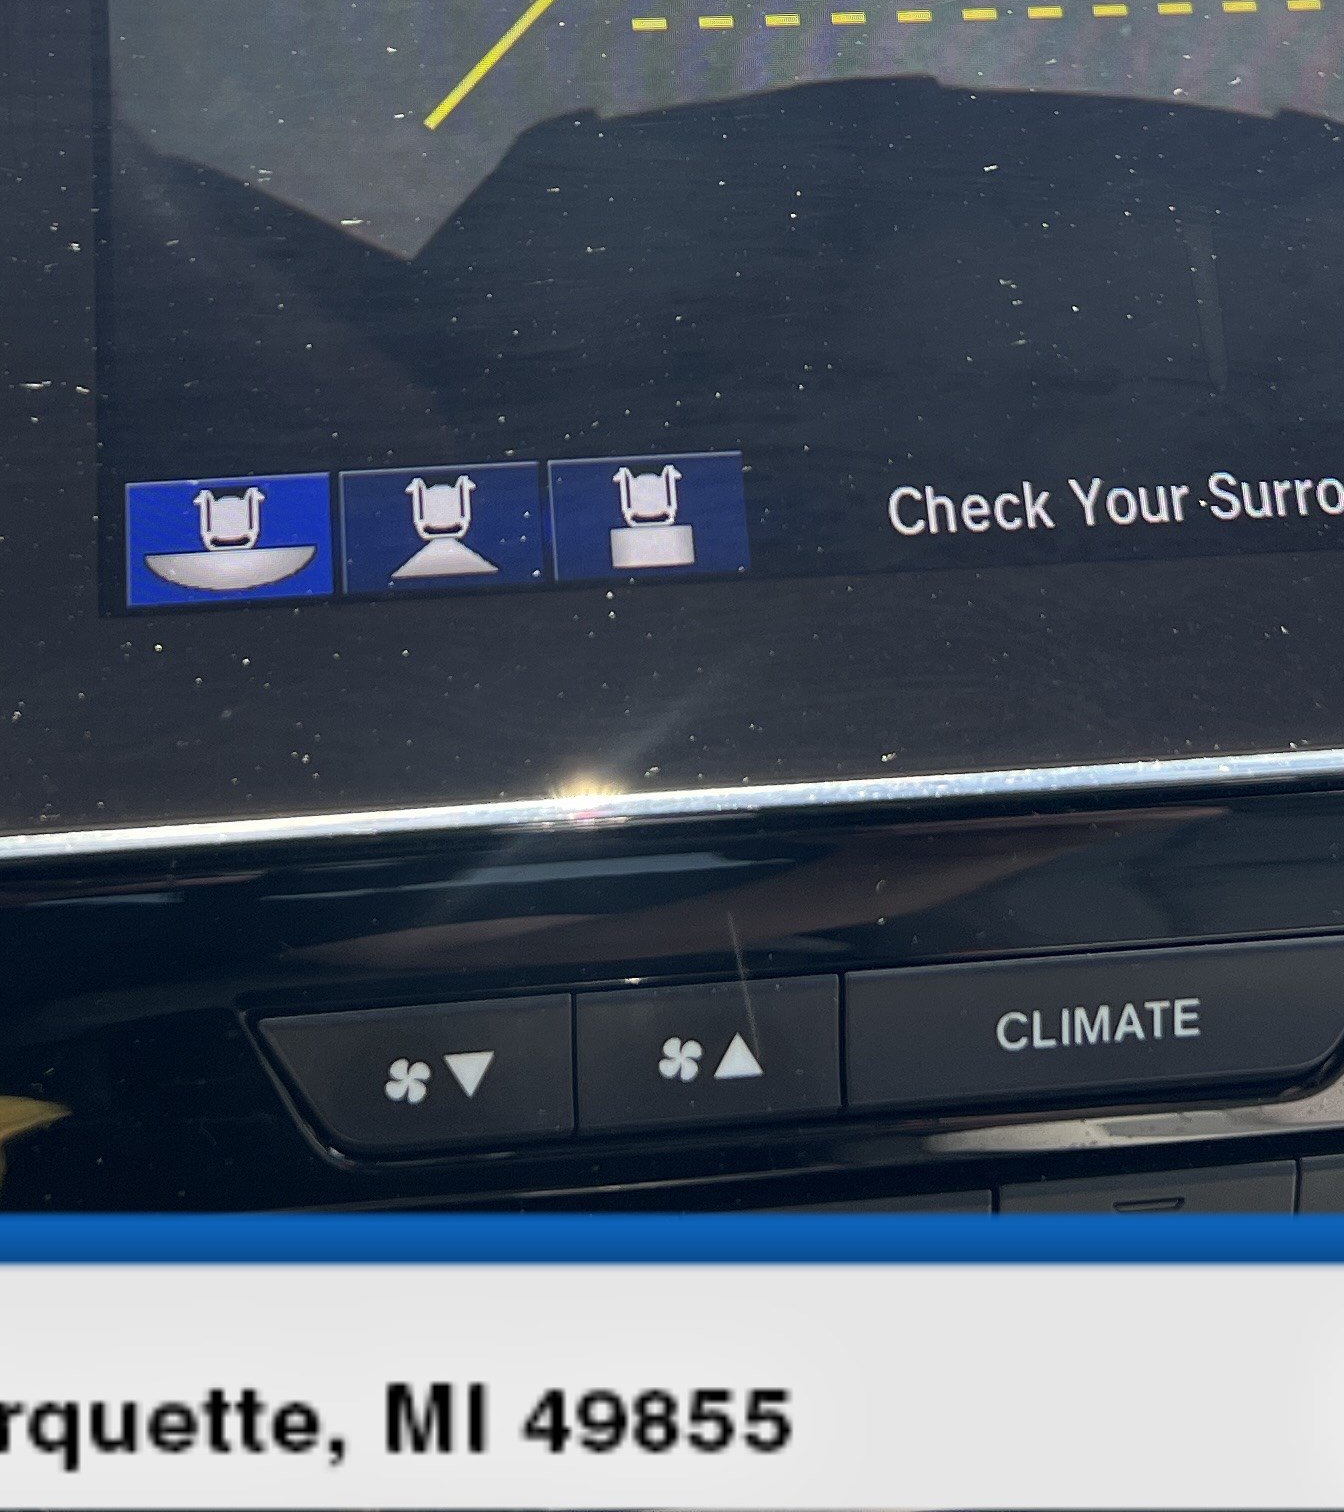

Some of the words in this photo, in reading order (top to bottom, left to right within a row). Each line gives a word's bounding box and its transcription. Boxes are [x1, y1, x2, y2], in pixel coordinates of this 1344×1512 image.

[887, 481, 1055, 536] Check
[1067, 477, 1191, 526] Your
[996, 998, 1201, 1051] CLIMATE
